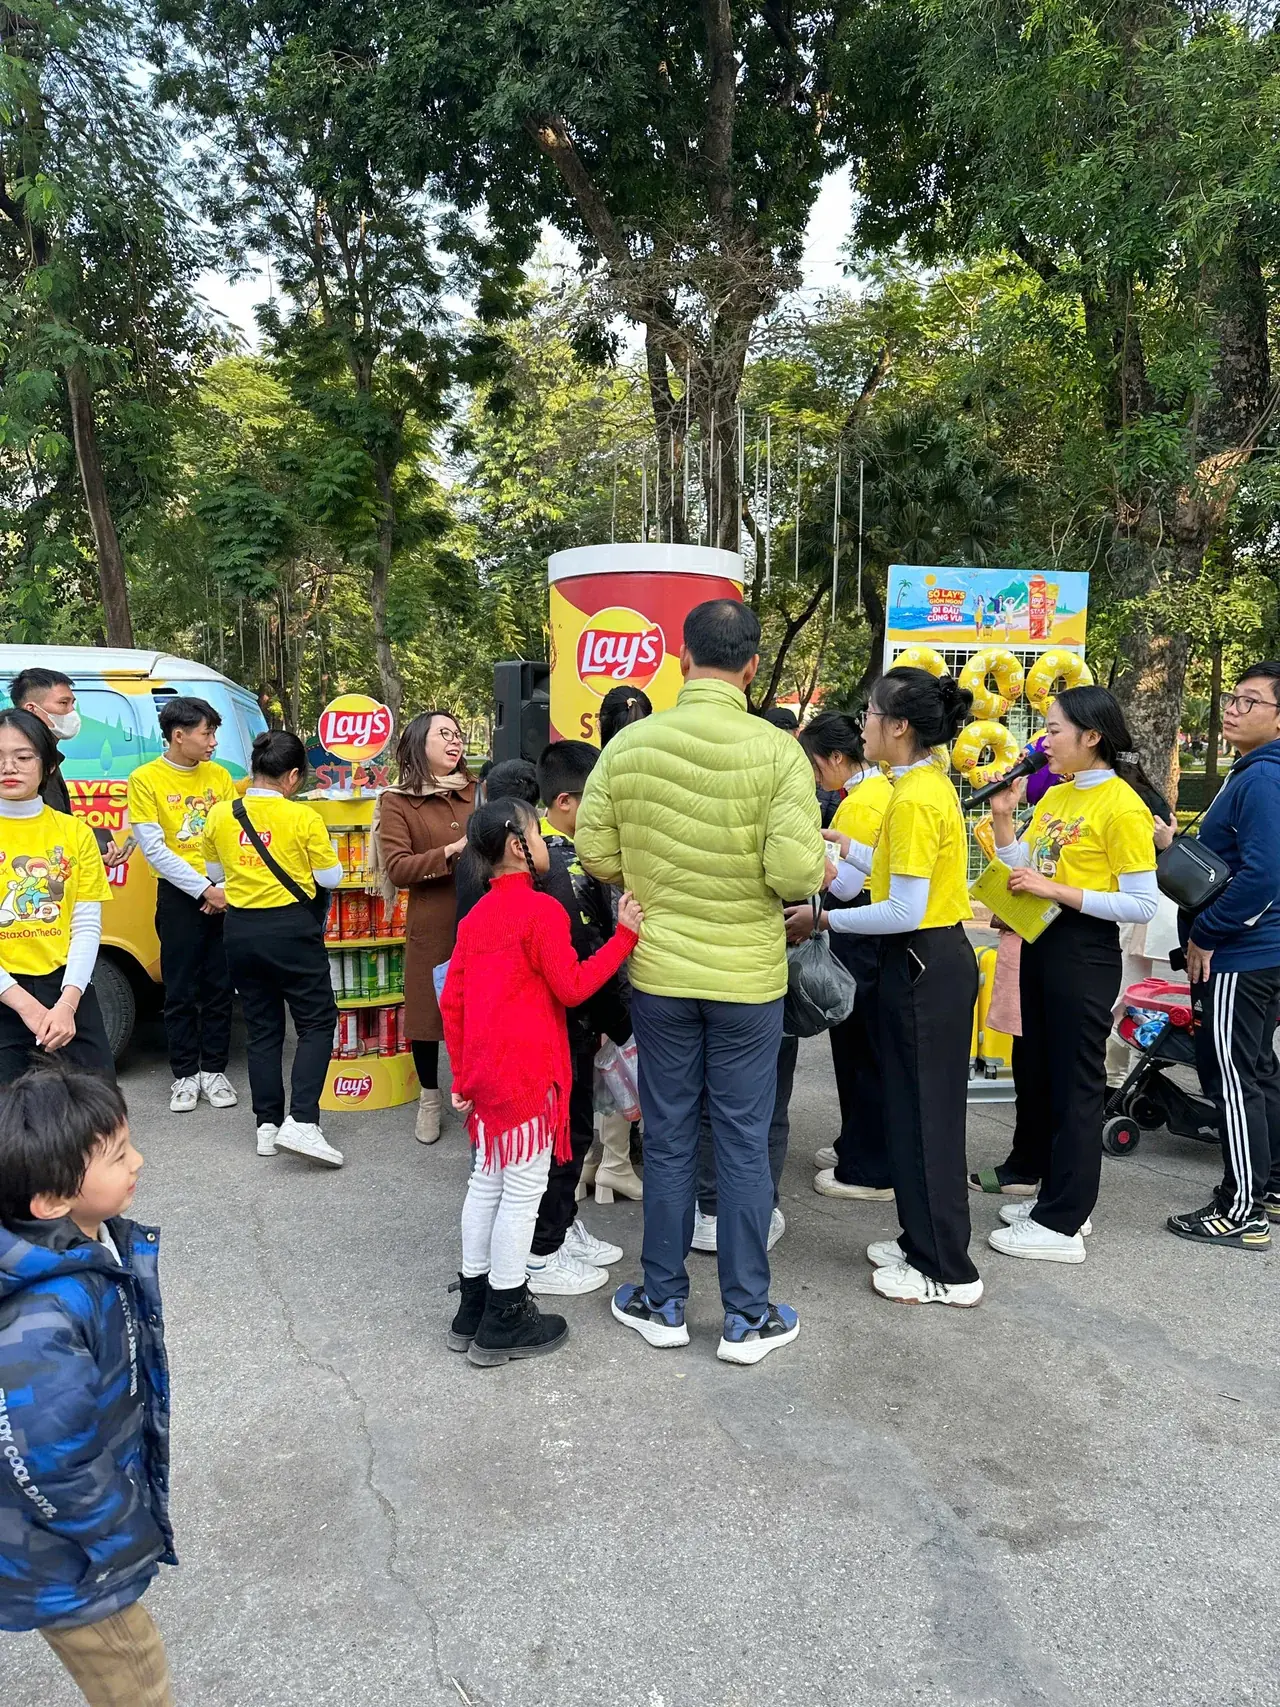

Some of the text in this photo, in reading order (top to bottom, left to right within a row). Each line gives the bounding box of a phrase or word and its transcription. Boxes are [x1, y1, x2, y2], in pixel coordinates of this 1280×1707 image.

[941, 589, 966, 599] LAY'S
[949, 614, 963, 622] VUI
[581, 629, 660, 680] Lay's
[325, 709, 387, 747] Lay's
[315, 764, 390, 790] STAX
[240, 856, 266, 867] STA
[335, 1075, 370, 1097] Lay's
[4, 1445, 31, 1487] COOL
